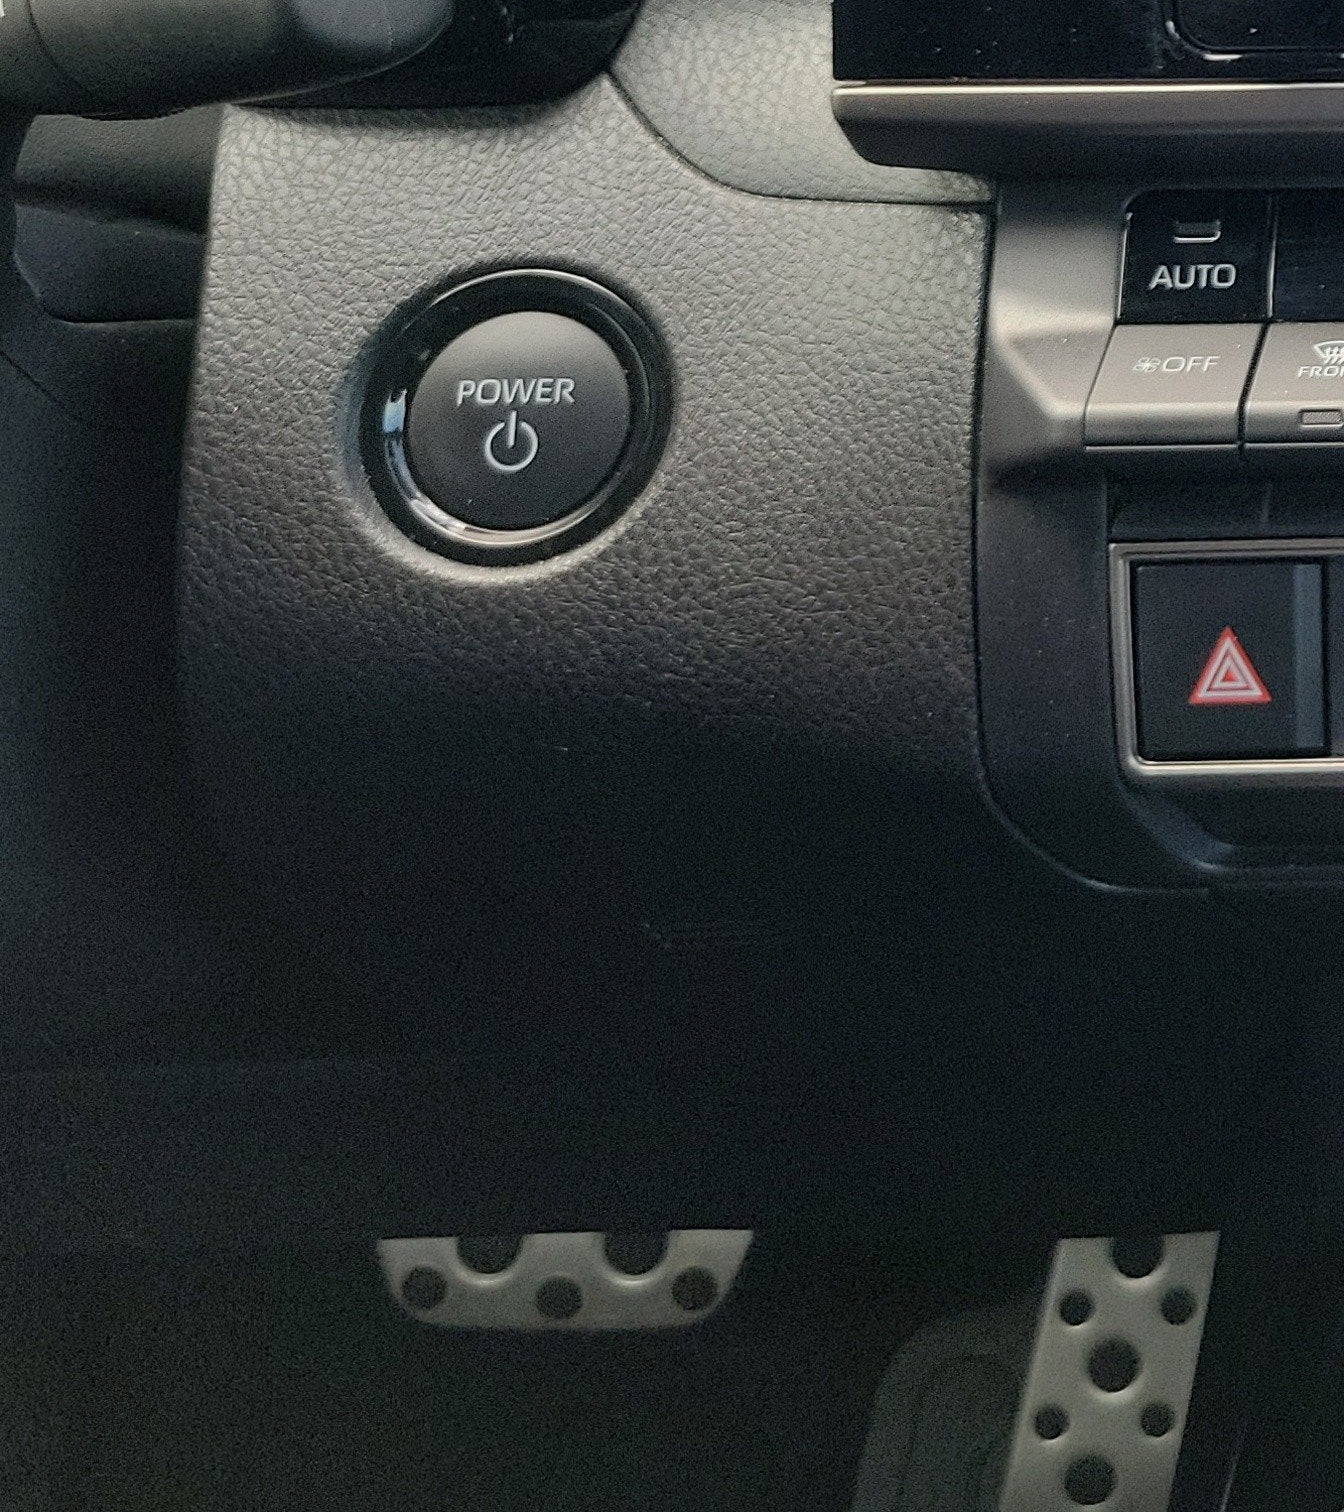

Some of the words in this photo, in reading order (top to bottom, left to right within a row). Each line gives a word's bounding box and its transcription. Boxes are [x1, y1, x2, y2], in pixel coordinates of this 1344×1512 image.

[1149, 264, 1235, 289] AUTO
[1162, 356, 1219, 372] OFF
[457, 379, 574, 405] POWER
